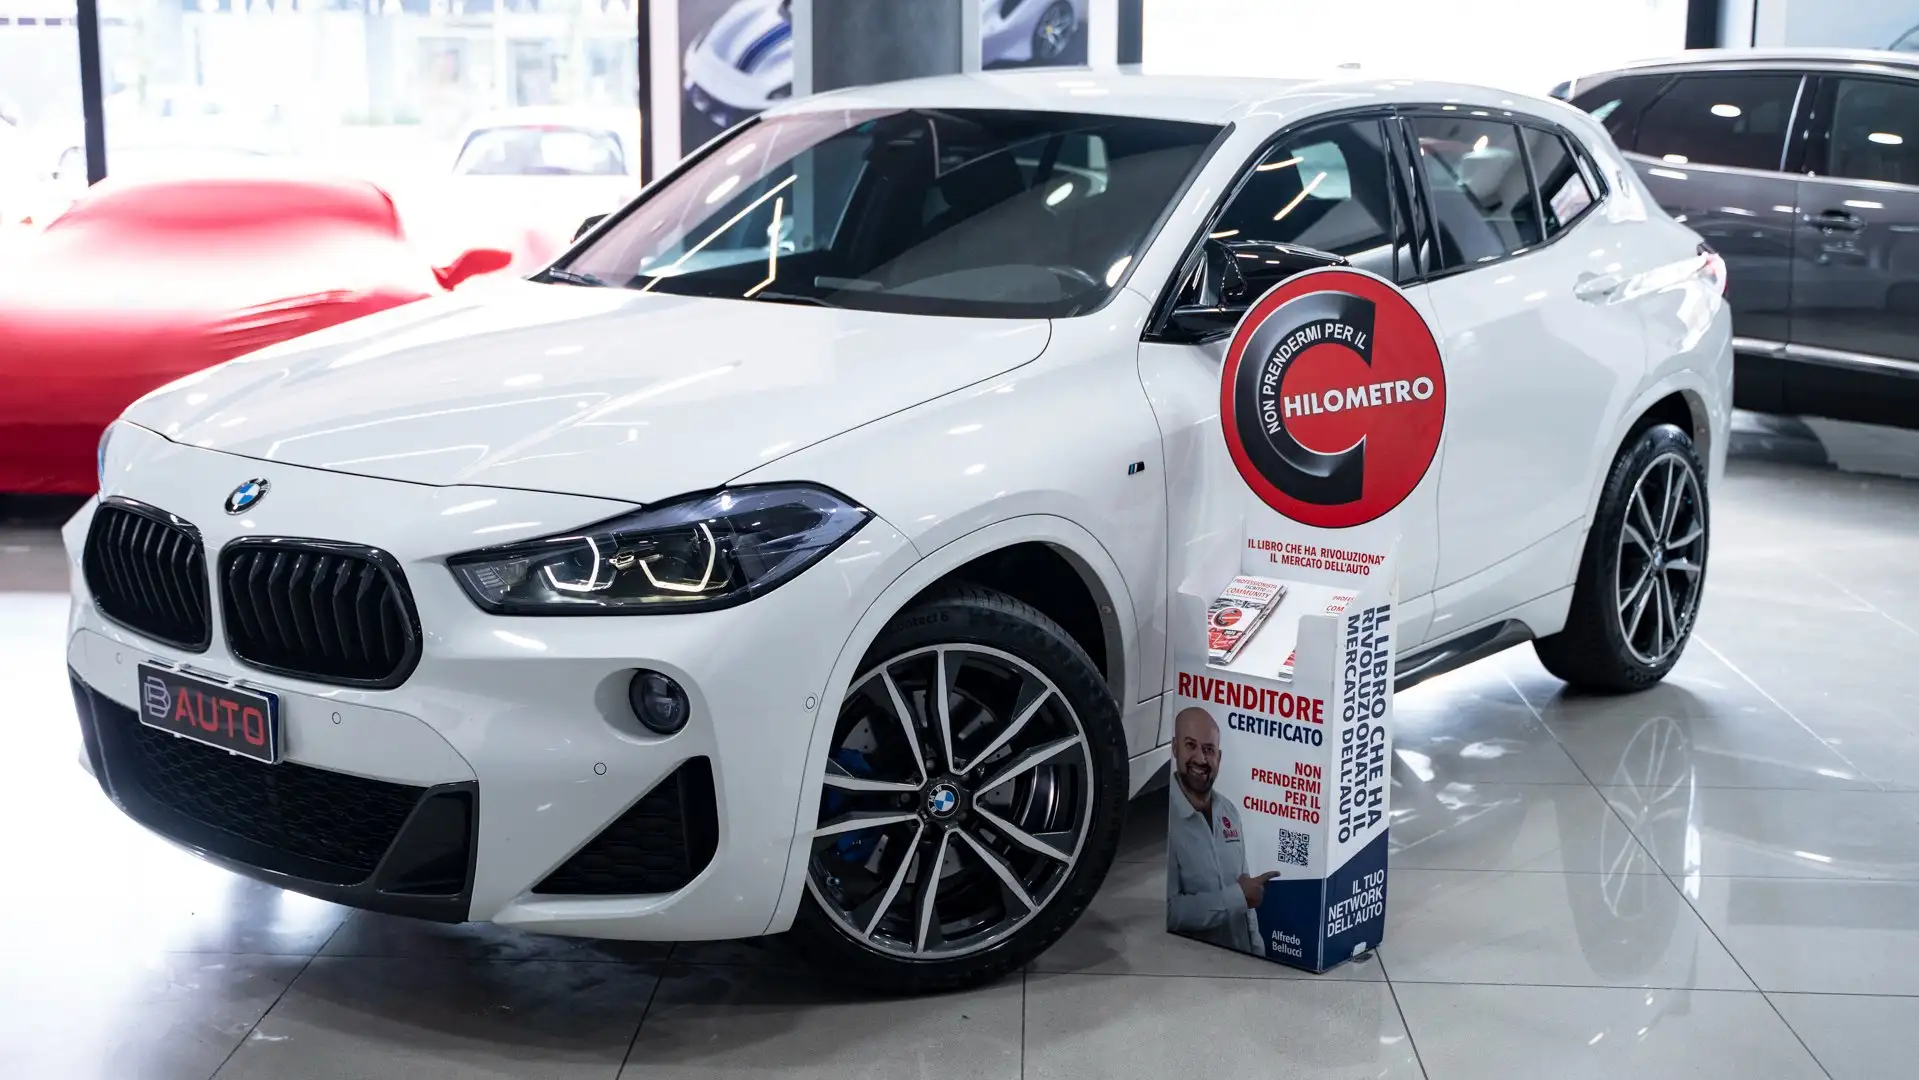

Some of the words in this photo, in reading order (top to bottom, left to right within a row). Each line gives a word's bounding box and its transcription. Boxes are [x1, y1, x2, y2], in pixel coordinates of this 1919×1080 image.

[1325, 323, 1354, 342] PER
[1354, 333, 1366, 349] IL
[1263, 324, 1322, 396] PRENDERMI
[1263, 400, 1281, 434] NON
[1248, 539, 1256, 549] IL
[1257, 540, 1283, 552] LIBRO
[1285, 543, 1302, 555] CHE
[1304, 546, 1317, 557] HA
[1320, 547, 1385, 566] RIVOLUZIONAT
[1270, 553, 1278, 563] IL
[1281, 554, 1322, 569] MERCATO
[1324, 561, 1370, 576] DELL'AUTO
[1227, 588, 1271, 599] COMMUNITY
[1375, 604, 1391, 631] IL
[1342, 614, 1360, 723] MERCATO
[1371, 635, 1390, 719] LIBRO
[1178, 671, 1324, 725] RIVENDITORE
[1354, 607, 1376, 807] RIVOLUZIONATO
[175, 686, 264, 746] AUTO
[1228, 712, 1323, 747] CERTIFICATO
[1369, 726, 1385, 781] CHE
[1251, 768, 1321, 795] PRENDERMI
[1294, 761, 1322, 780] NON
[1338, 727, 1354, 844] DELL'AUTO
[1243, 795, 1320, 825] CHILOMETRO
[1284, 791, 1308, 808] PER
[1310, 794, 1321, 810] IL
[1367, 786, 1383, 829] HA
[1353, 812, 1366, 837] IL
[1352, 878, 1362, 895] IL
[1363, 869, 1385, 889] TUO
[1328, 884, 1383, 922] NETWORK
[1327, 901, 1383, 938] DELL'AUTO
[1271, 929, 1301, 946] Alfredo
[1272, 941, 1302, 958] Bellucci
